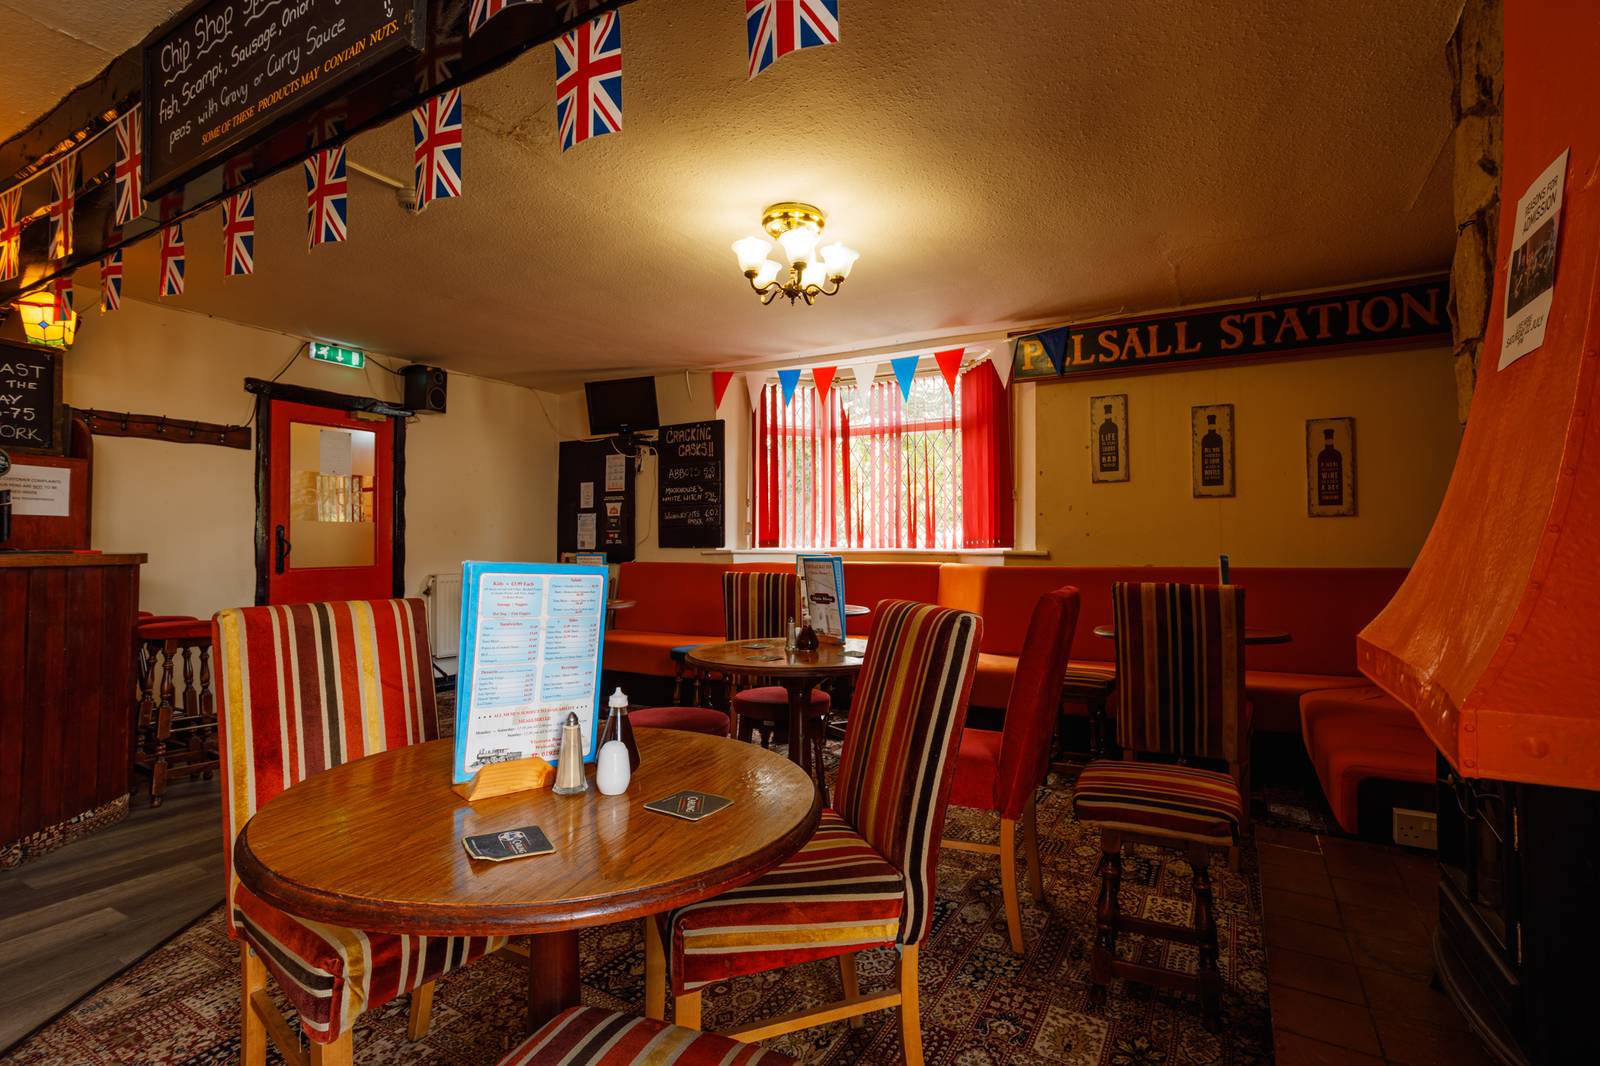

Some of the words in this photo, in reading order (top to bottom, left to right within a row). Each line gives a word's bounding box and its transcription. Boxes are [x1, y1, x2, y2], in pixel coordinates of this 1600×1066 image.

[161, 38, 190, 73] Chip
[194, 6, 233, 49] Shop
[231, 22, 282, 67] Sausage,
[169, 120, 191, 153] peas
[198, 98, 218, 125] with
[220, 84, 248, 107] Gravy
[253, 73, 264, 87] or
[267, 46, 300, 77] Curry
[306, 18, 346, 55] Sauce
[201, 126, 221, 146] SOME
[221, 119, 232, 134] OF
[232, 105, 255, 128] THESE
[257, 78, 300, 113] PRODUCTS
[300, 66, 320, 88] MAY
[323, 38, 367, 73] CONTAIN
[369, 19, 400, 47] NUTS.
[1547, 175, 1559, 195] FOR
[1022, 321, 1201, 371] PLSALL
[1220, 288, 1441, 351] STATION
[5, 379, 38, 390] THE
[666, 426, 712, 444] CRACKING
